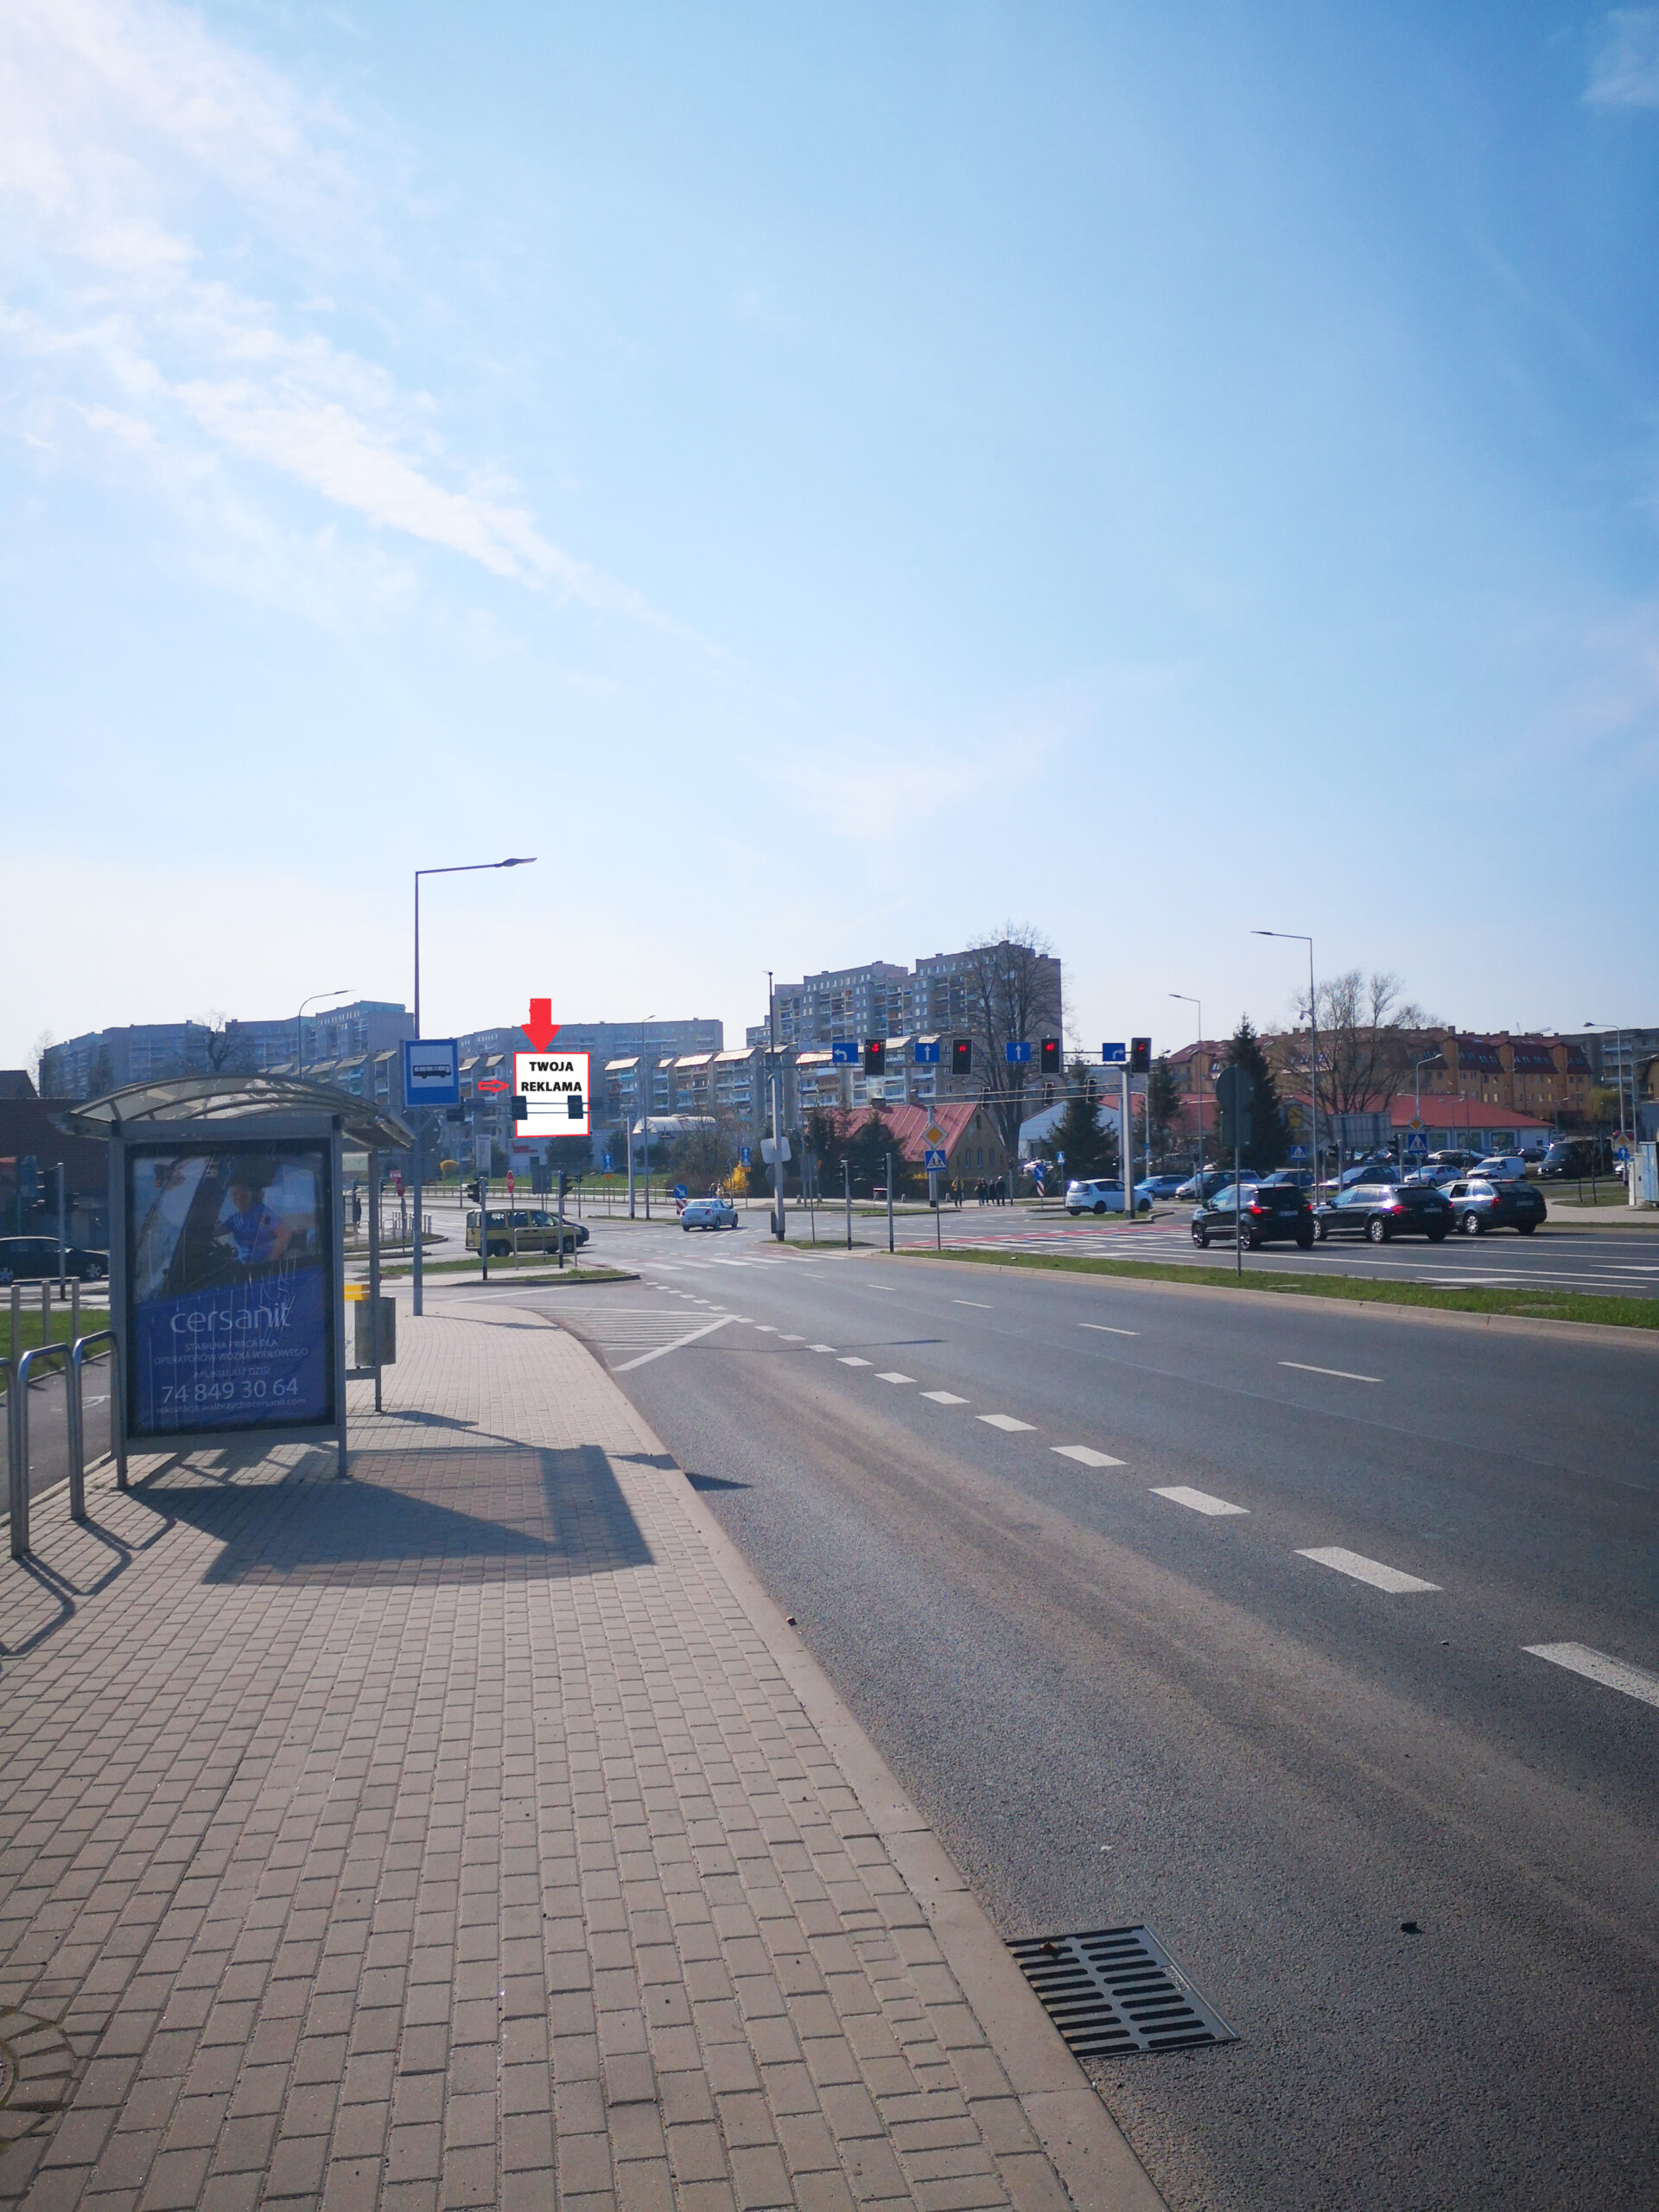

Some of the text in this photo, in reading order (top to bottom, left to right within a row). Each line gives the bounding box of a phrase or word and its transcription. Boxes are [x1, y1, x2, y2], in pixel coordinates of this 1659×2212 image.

[170, 1302, 291, 1332] cersanit
[185, 1341, 227, 1351] STABILNA
[229, 1339, 257, 1349] PRACA
[162, 1377, 299, 1404] 74 849 30 64
